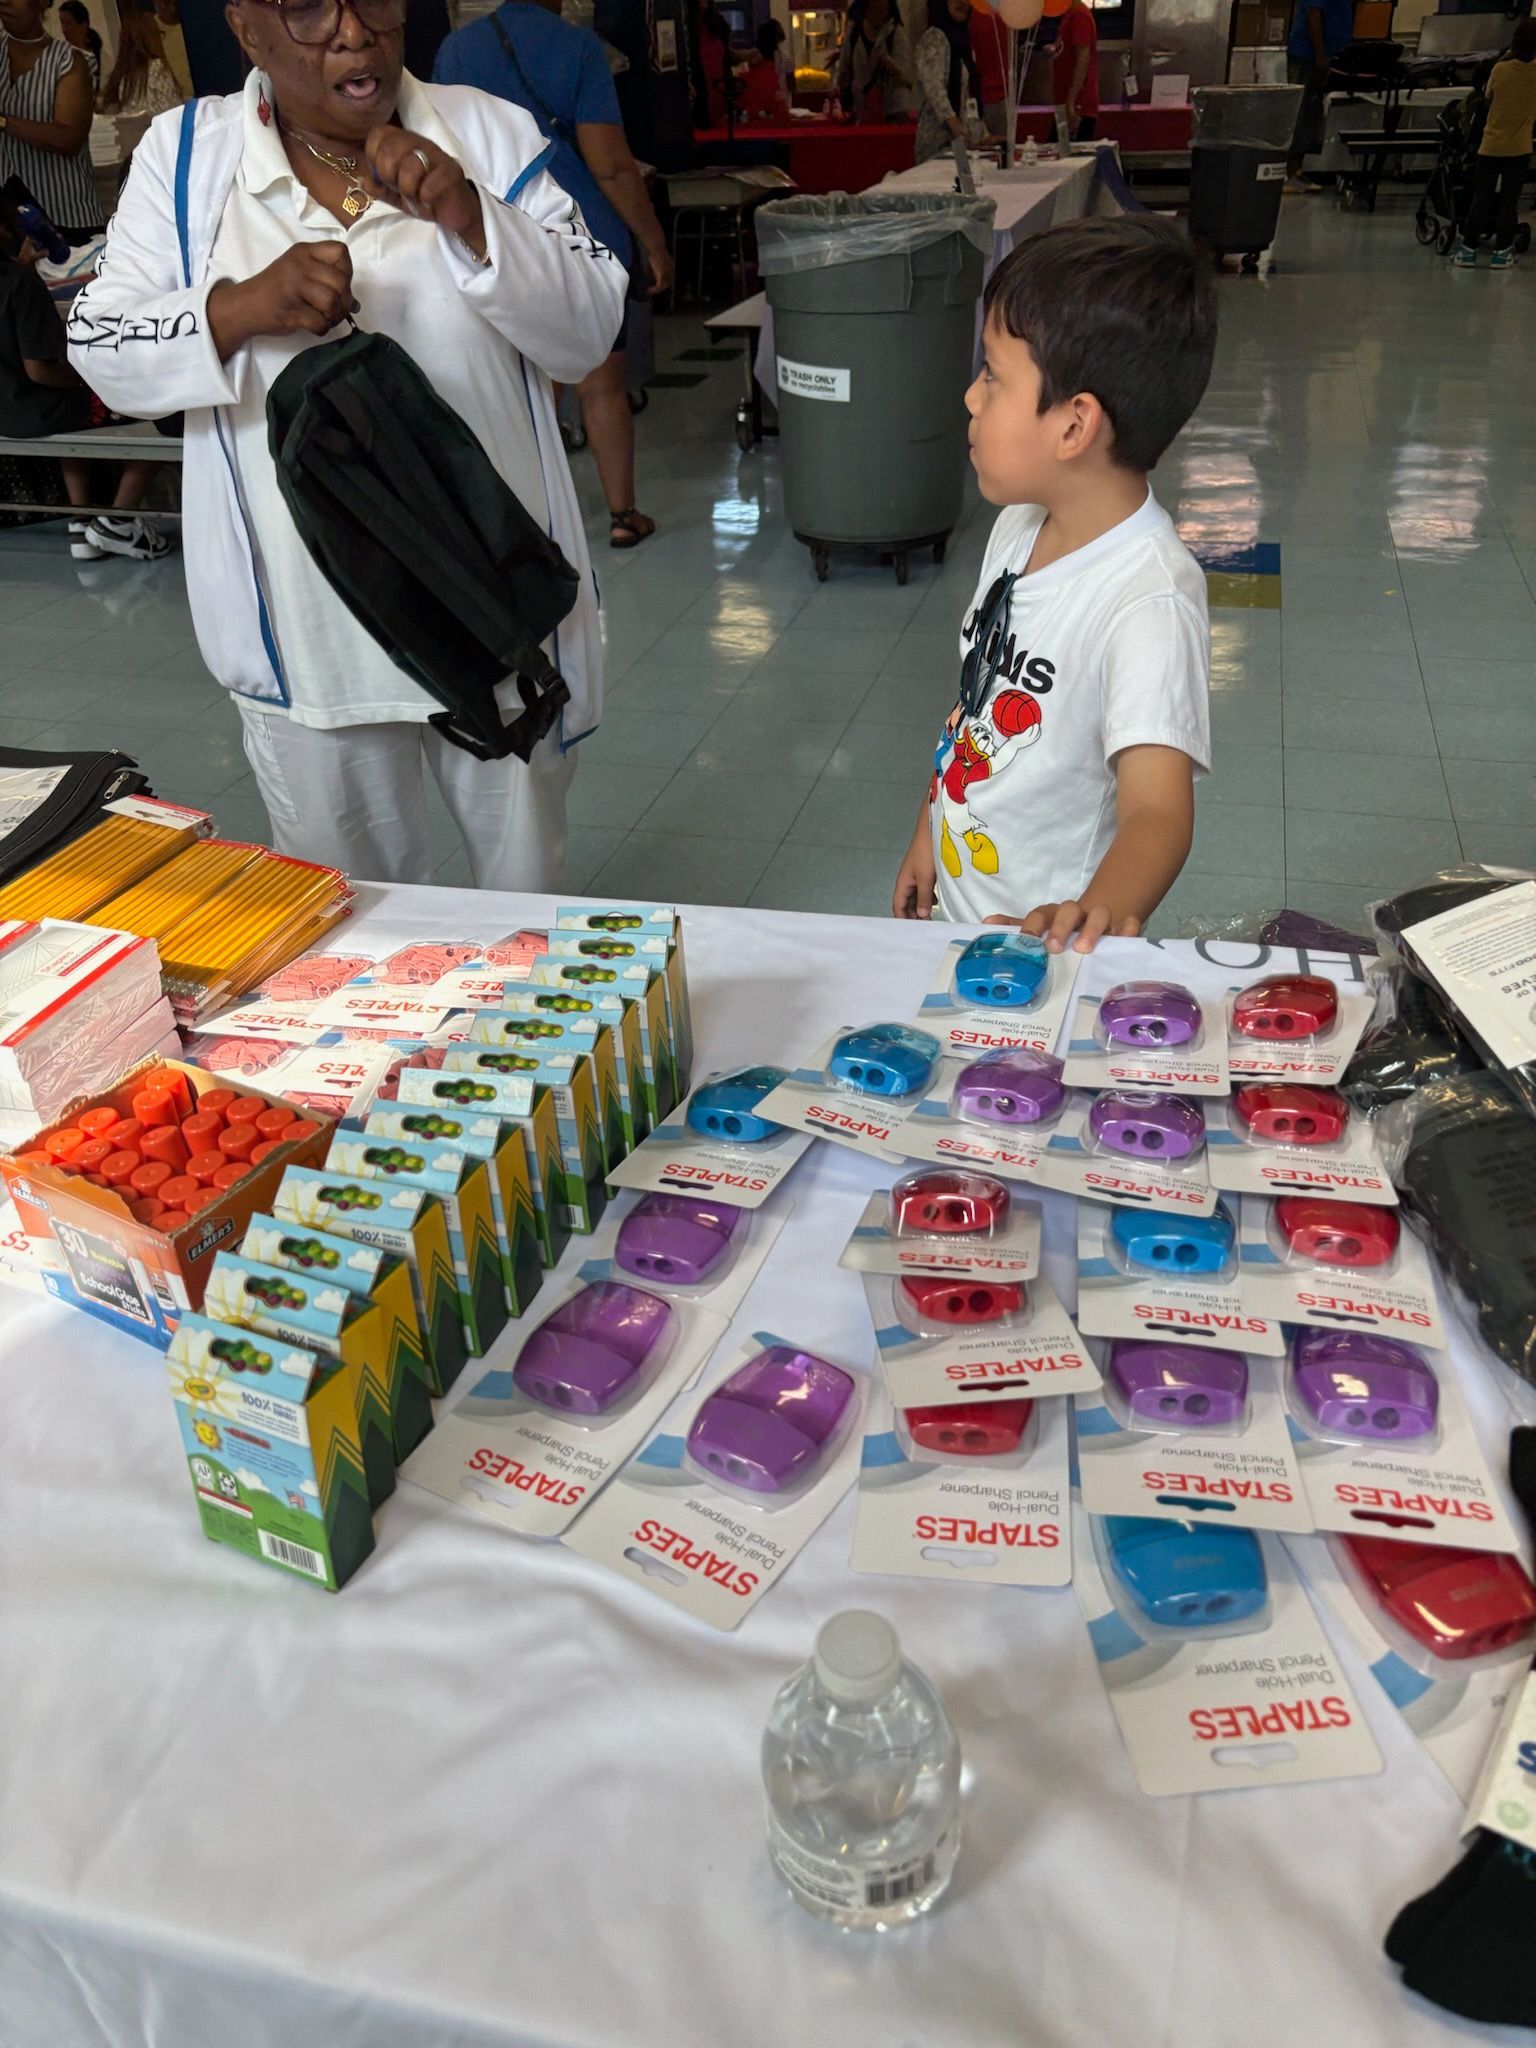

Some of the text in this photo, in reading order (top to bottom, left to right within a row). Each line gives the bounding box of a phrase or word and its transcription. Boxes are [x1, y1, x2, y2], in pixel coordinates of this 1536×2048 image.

[789, 369, 837, 385] TRASH ONLY
[950, 1029, 1046, 1051] STAPLES
[1110, 1067, 1219, 1083] STAPLES
[1229, 1059, 1336, 1073] STAPLES
[806, 1105, 891, 1140] TAPLES
[663, 1164, 767, 1191] STAPLES
[1085, 1173, 1204, 1204] STAPLES
[1260, 1167, 1383, 1189] STAPLES
[58, 1225, 88, 1258] 30
[191, 1220, 232, 1258] ELMER'S
[351, 1227, 381, 1242] 100%
[898, 1251, 1027, 1270] STAPLES
[80, 1271, 114, 1297] School
[1134, 1305, 1267, 1334] STAPLES
[1297, 1293, 1432, 1327] STAPLES
[945, 1353, 1083, 1380] STAPLES
[241, 1391, 272, 1411] 100%
[515, 1426, 612, 1472] Pencil Sharpener
[1160, 1447, 1285, 1466] Pencil Sharpener
[469, 1447, 586, 1506] STAPLES
[543, 1453, 603, 1482] Dual-Hole
[1213, 1462, 1288, 1478] Dual-Hole
[1351, 1459, 1430, 1479] Sharpener
[938, 1481, 1060, 1502] Pencil Sharpener
[1143, 1471, 1294, 1503] STAPLES
[1406, 1476, 1487, 1498] Dual-Hole
[988, 1500, 1060, 1515] Dual-Hole
[1335, 1483, 1494, 1522] STAPLES
[685, 1498, 787, 1559] Pencil Sharpener
[916, 1515, 1060, 1548] STAPLES
[634, 1519, 759, 1596] STAPLES
[714, 1530, 778, 1571] Dual-Hole
[1193, 1652, 1327, 1678] Pencil Sharpener
[1255, 1669, 1335, 1692] Dual-Hole
[1188, 1695, 1353, 1741] STAPLES
